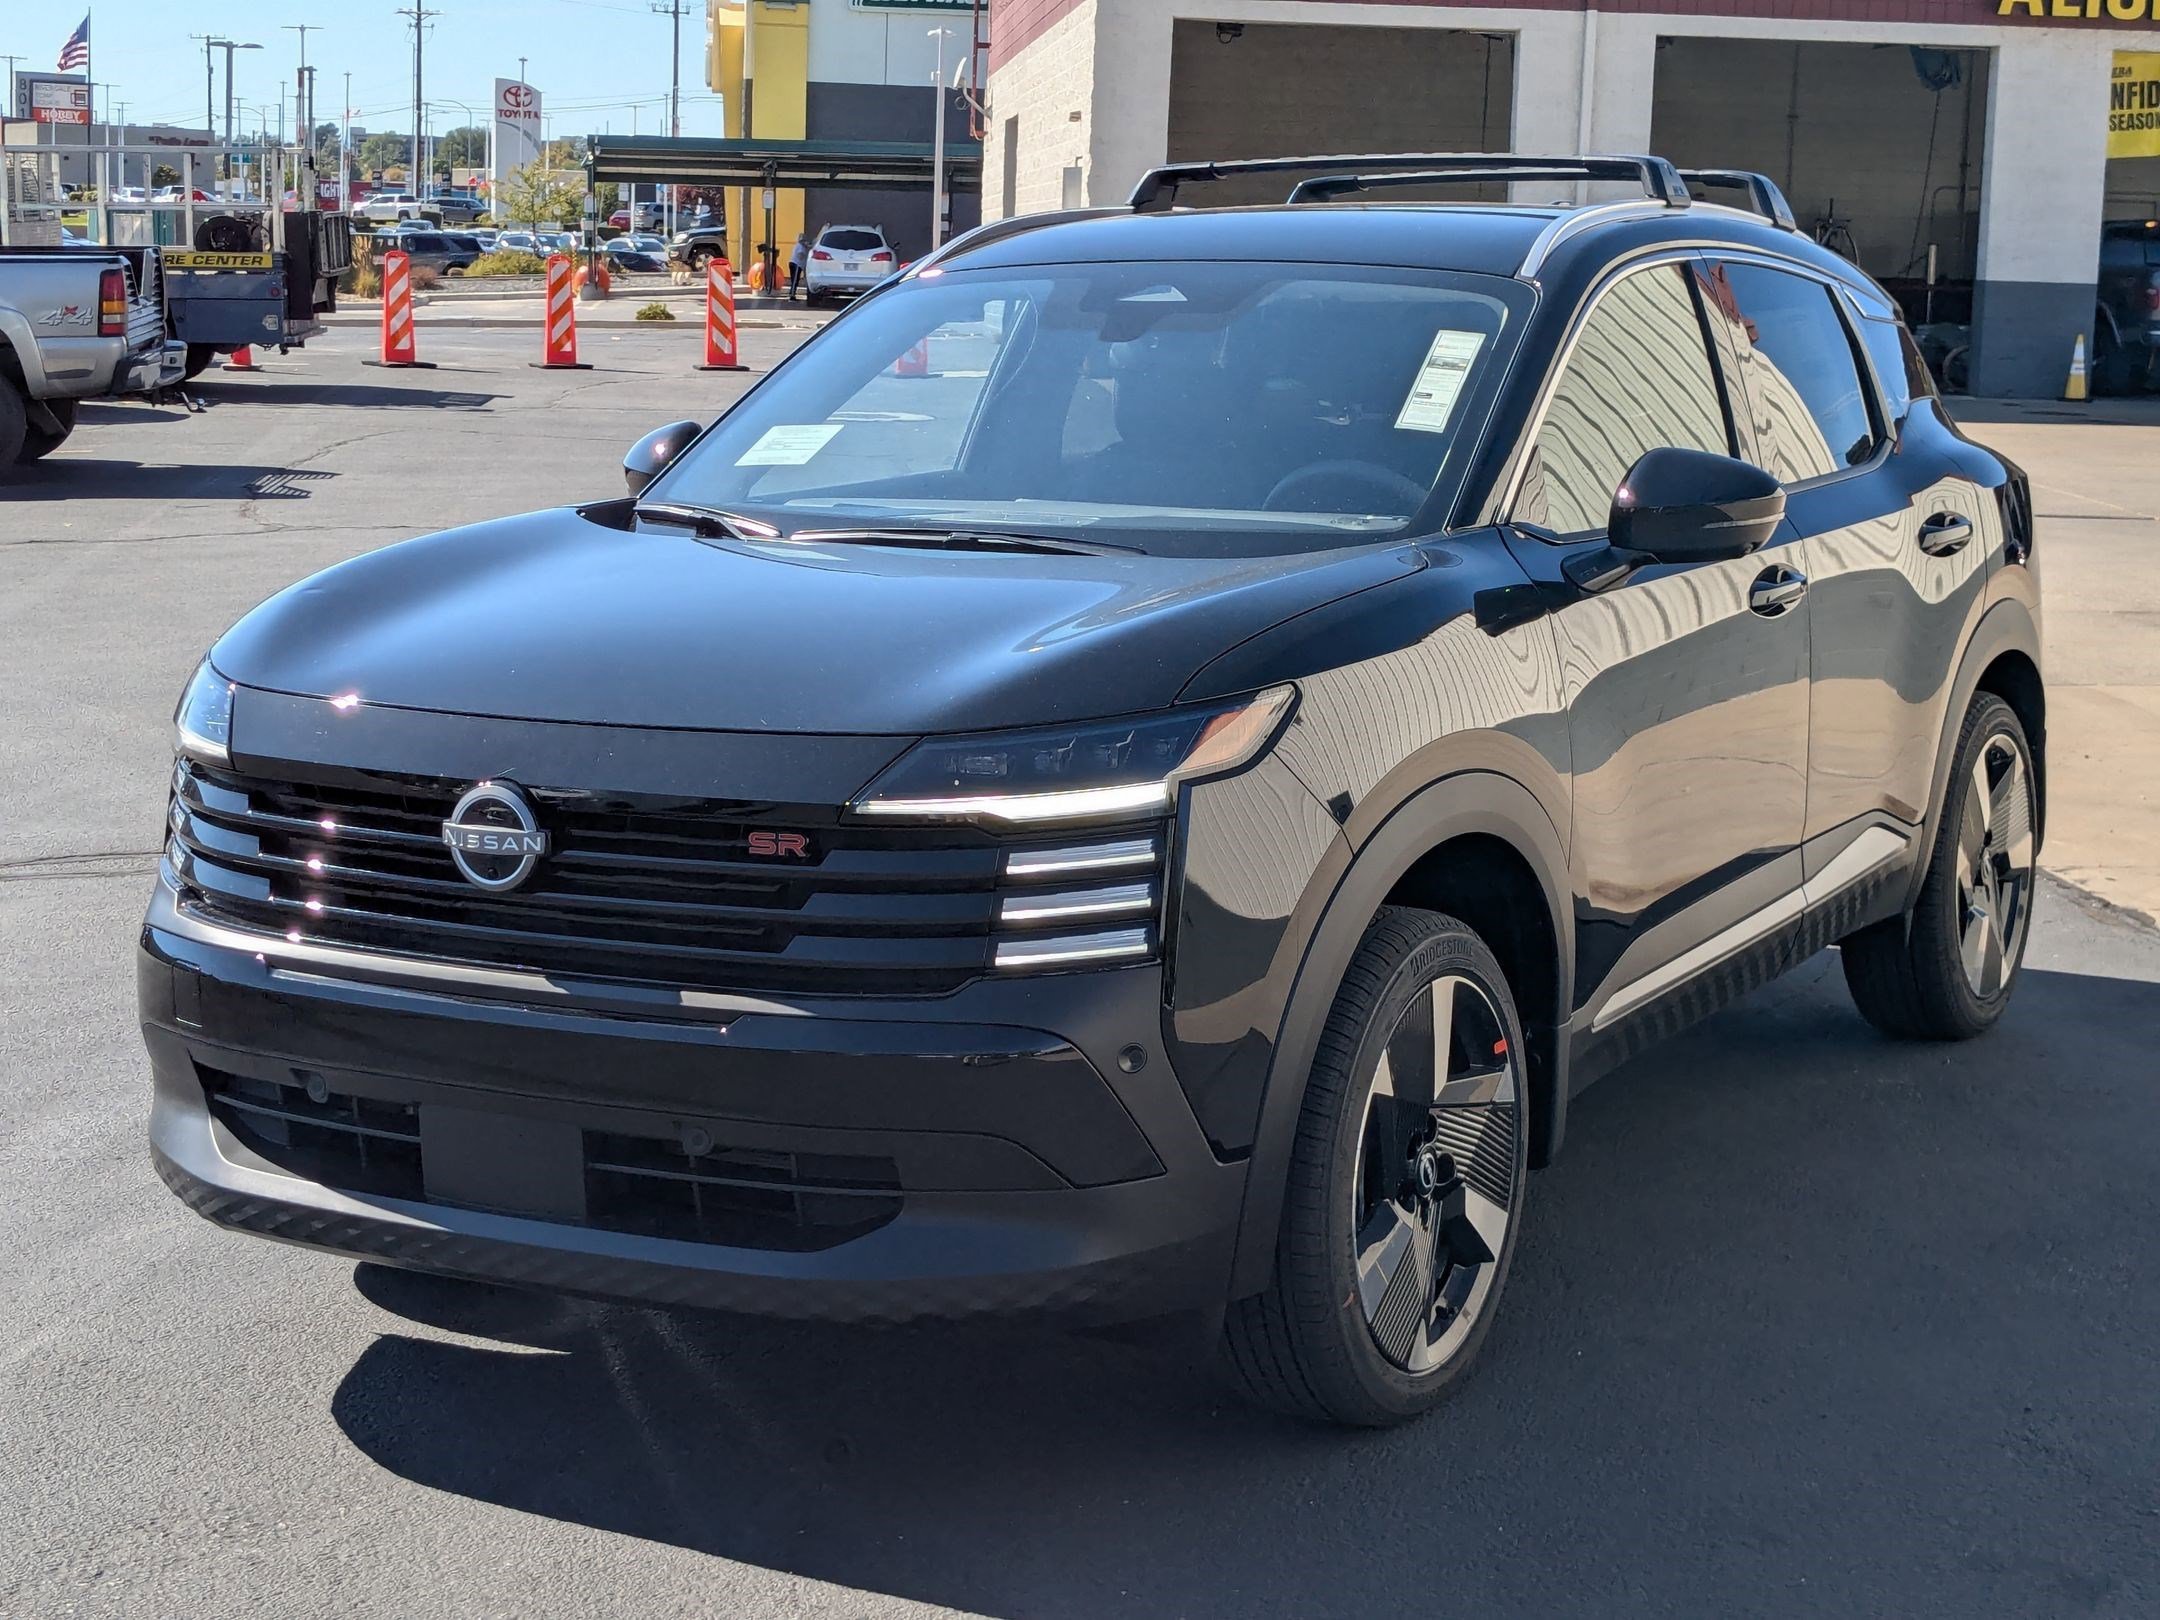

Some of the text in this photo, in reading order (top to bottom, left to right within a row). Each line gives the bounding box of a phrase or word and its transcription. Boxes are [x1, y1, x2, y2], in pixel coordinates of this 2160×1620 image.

[192, 255, 264, 266] CENTER
[444, 829, 541, 851] NISSAN
[748, 832, 806, 857] SR
[1409, 939, 1474, 978] BRIDGESTONE
